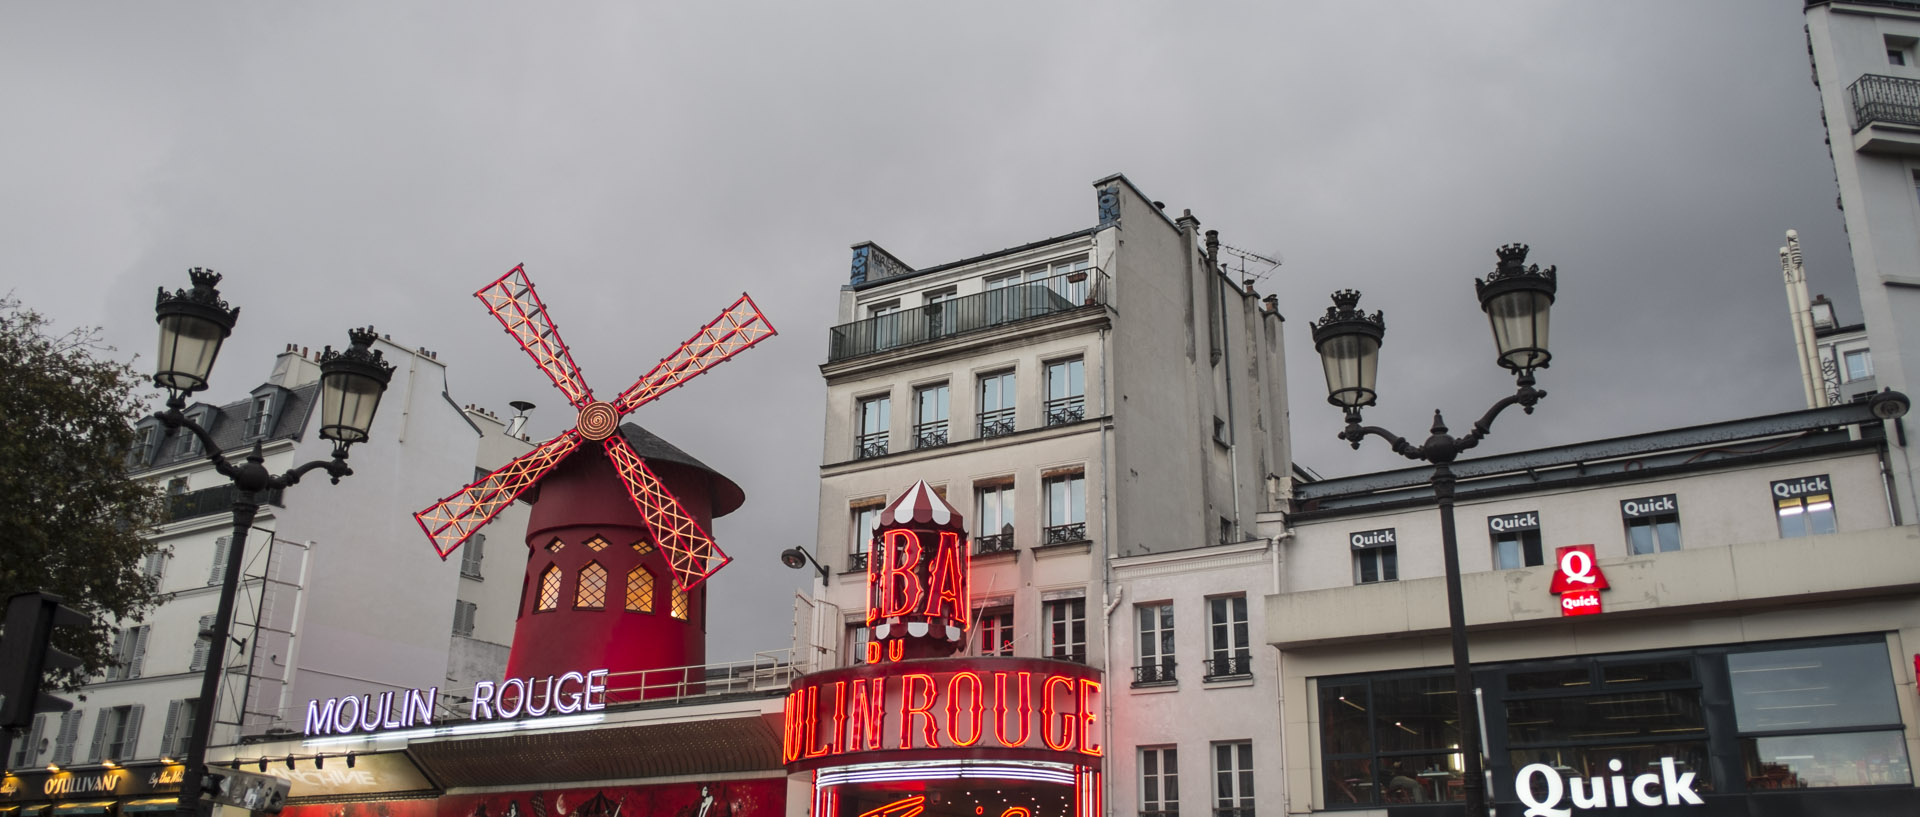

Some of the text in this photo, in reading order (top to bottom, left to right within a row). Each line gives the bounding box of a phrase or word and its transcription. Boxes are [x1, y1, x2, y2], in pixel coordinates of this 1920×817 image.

[1773, 478, 1829, 498] Quick
[1623, 497, 1674, 516] Quick
[1490, 511, 1537, 532] Quick
[1352, 531, 1395, 547] Quick
[1561, 551, 1596, 584] Q
[1562, 595, 1599, 610] Quick
[867, 639, 904, 664] DU
[304, 669, 609, 735] MOULIN ROUGE
[783, 671, 1103, 765] ULIN ROUGE
[1515, 757, 1705, 817] Quick
